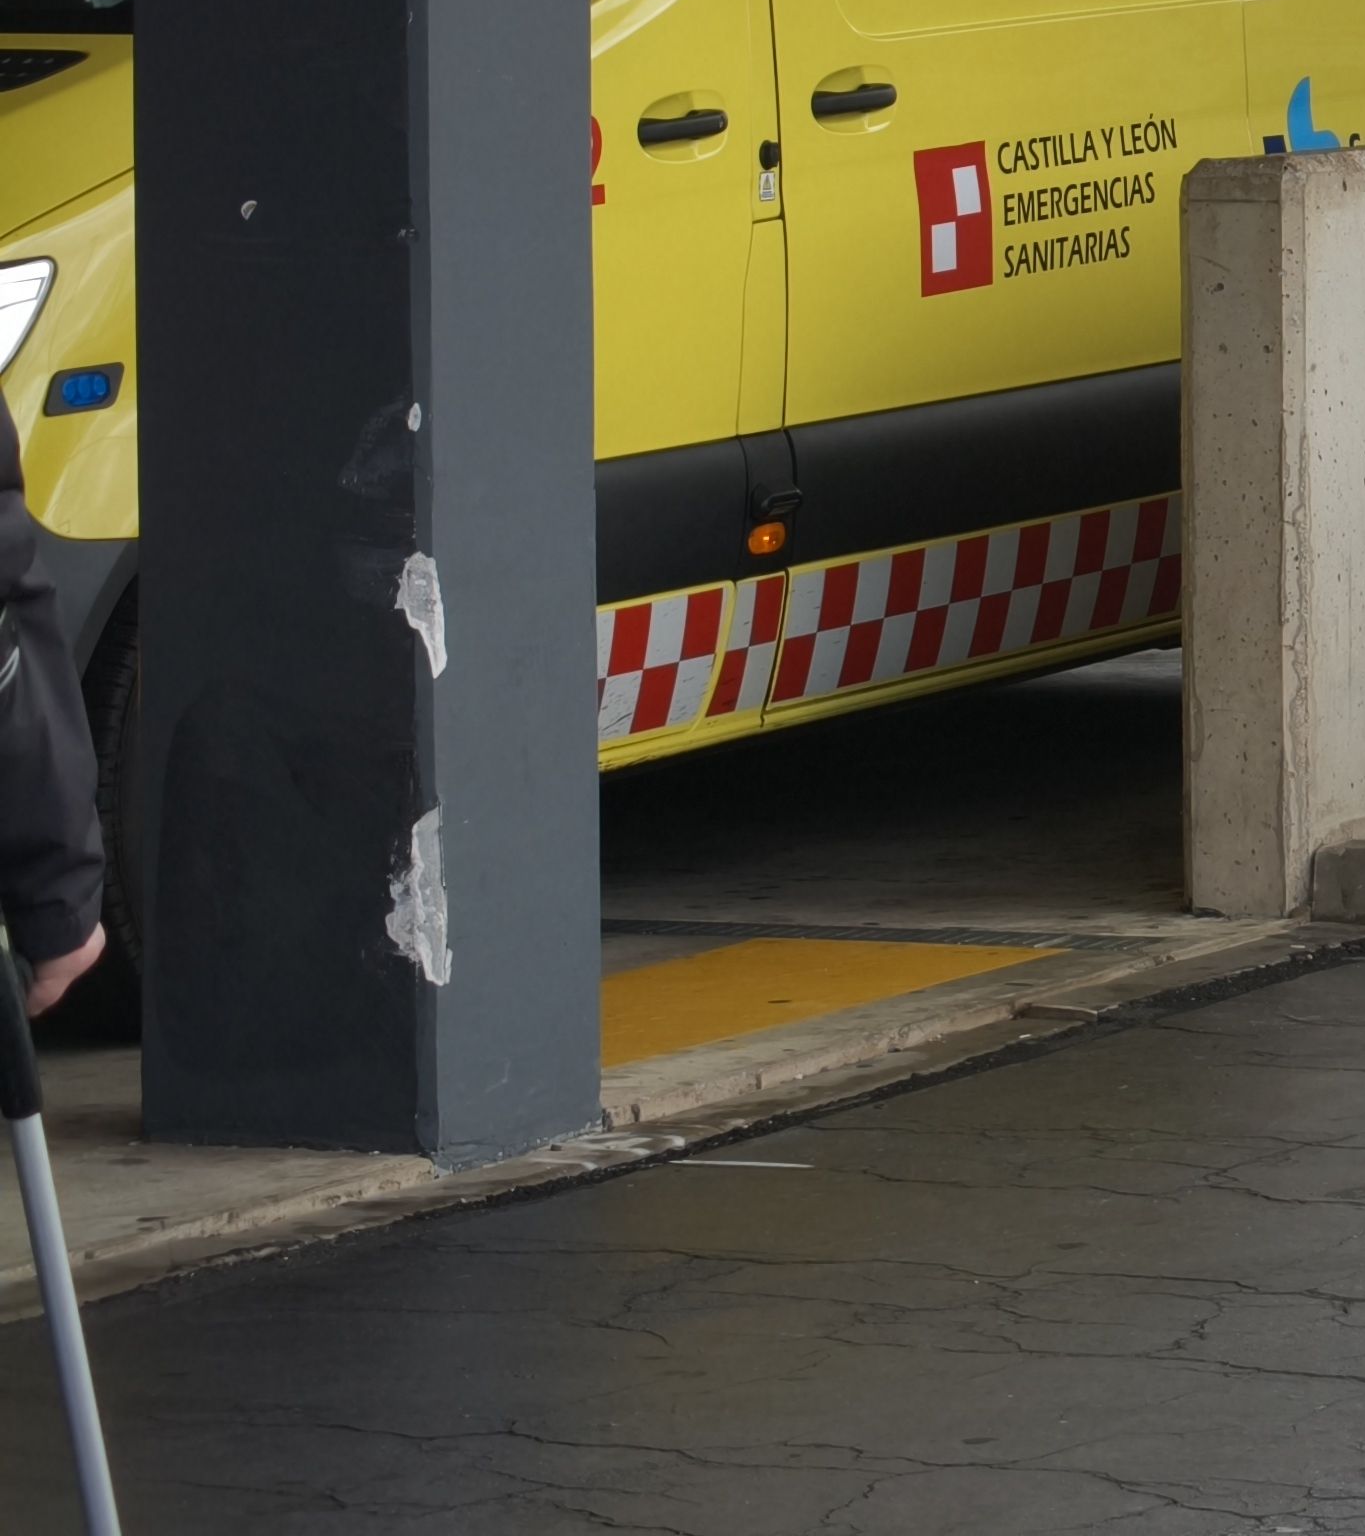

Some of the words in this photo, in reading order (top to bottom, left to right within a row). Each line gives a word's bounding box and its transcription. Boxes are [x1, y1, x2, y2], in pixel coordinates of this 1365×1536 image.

[997, 130, 1099, 174] CASTILLA
[1101, 127, 1114, 159] Y
[1119, 113, 1178, 157] LEÓN
[1003, 171, 1155, 227] EMERGENCIAS
[1004, 226, 1131, 279] SANITARIAS
